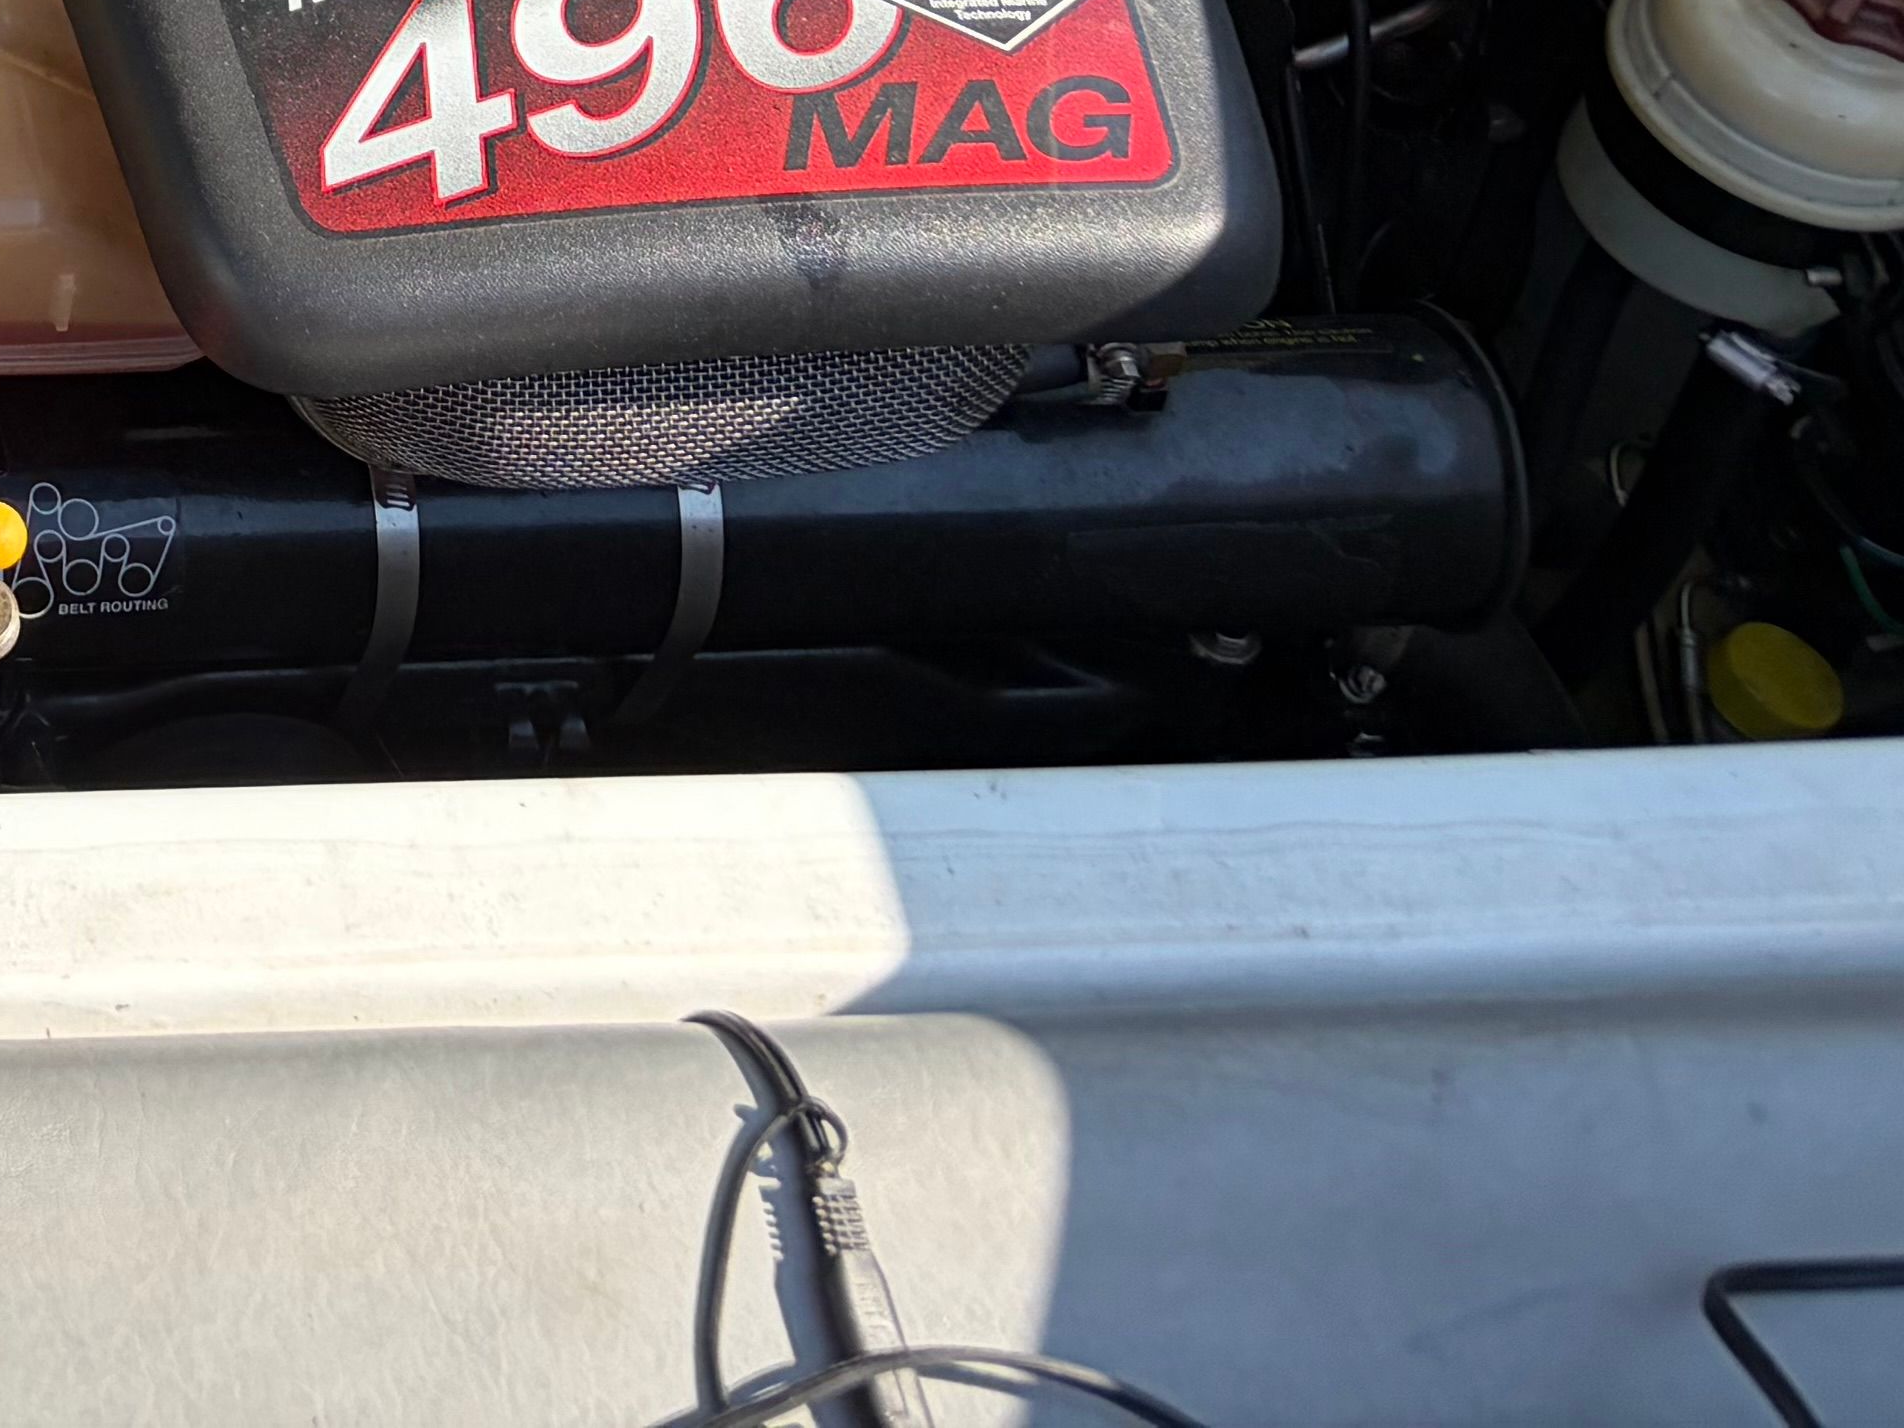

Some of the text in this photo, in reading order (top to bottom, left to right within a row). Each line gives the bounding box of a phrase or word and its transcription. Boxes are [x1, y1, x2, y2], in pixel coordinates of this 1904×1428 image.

[955, 8, 1032, 21] Technology
[781, 77, 1134, 174] MAG
[57, 597, 169, 617] BELT ROUTING
